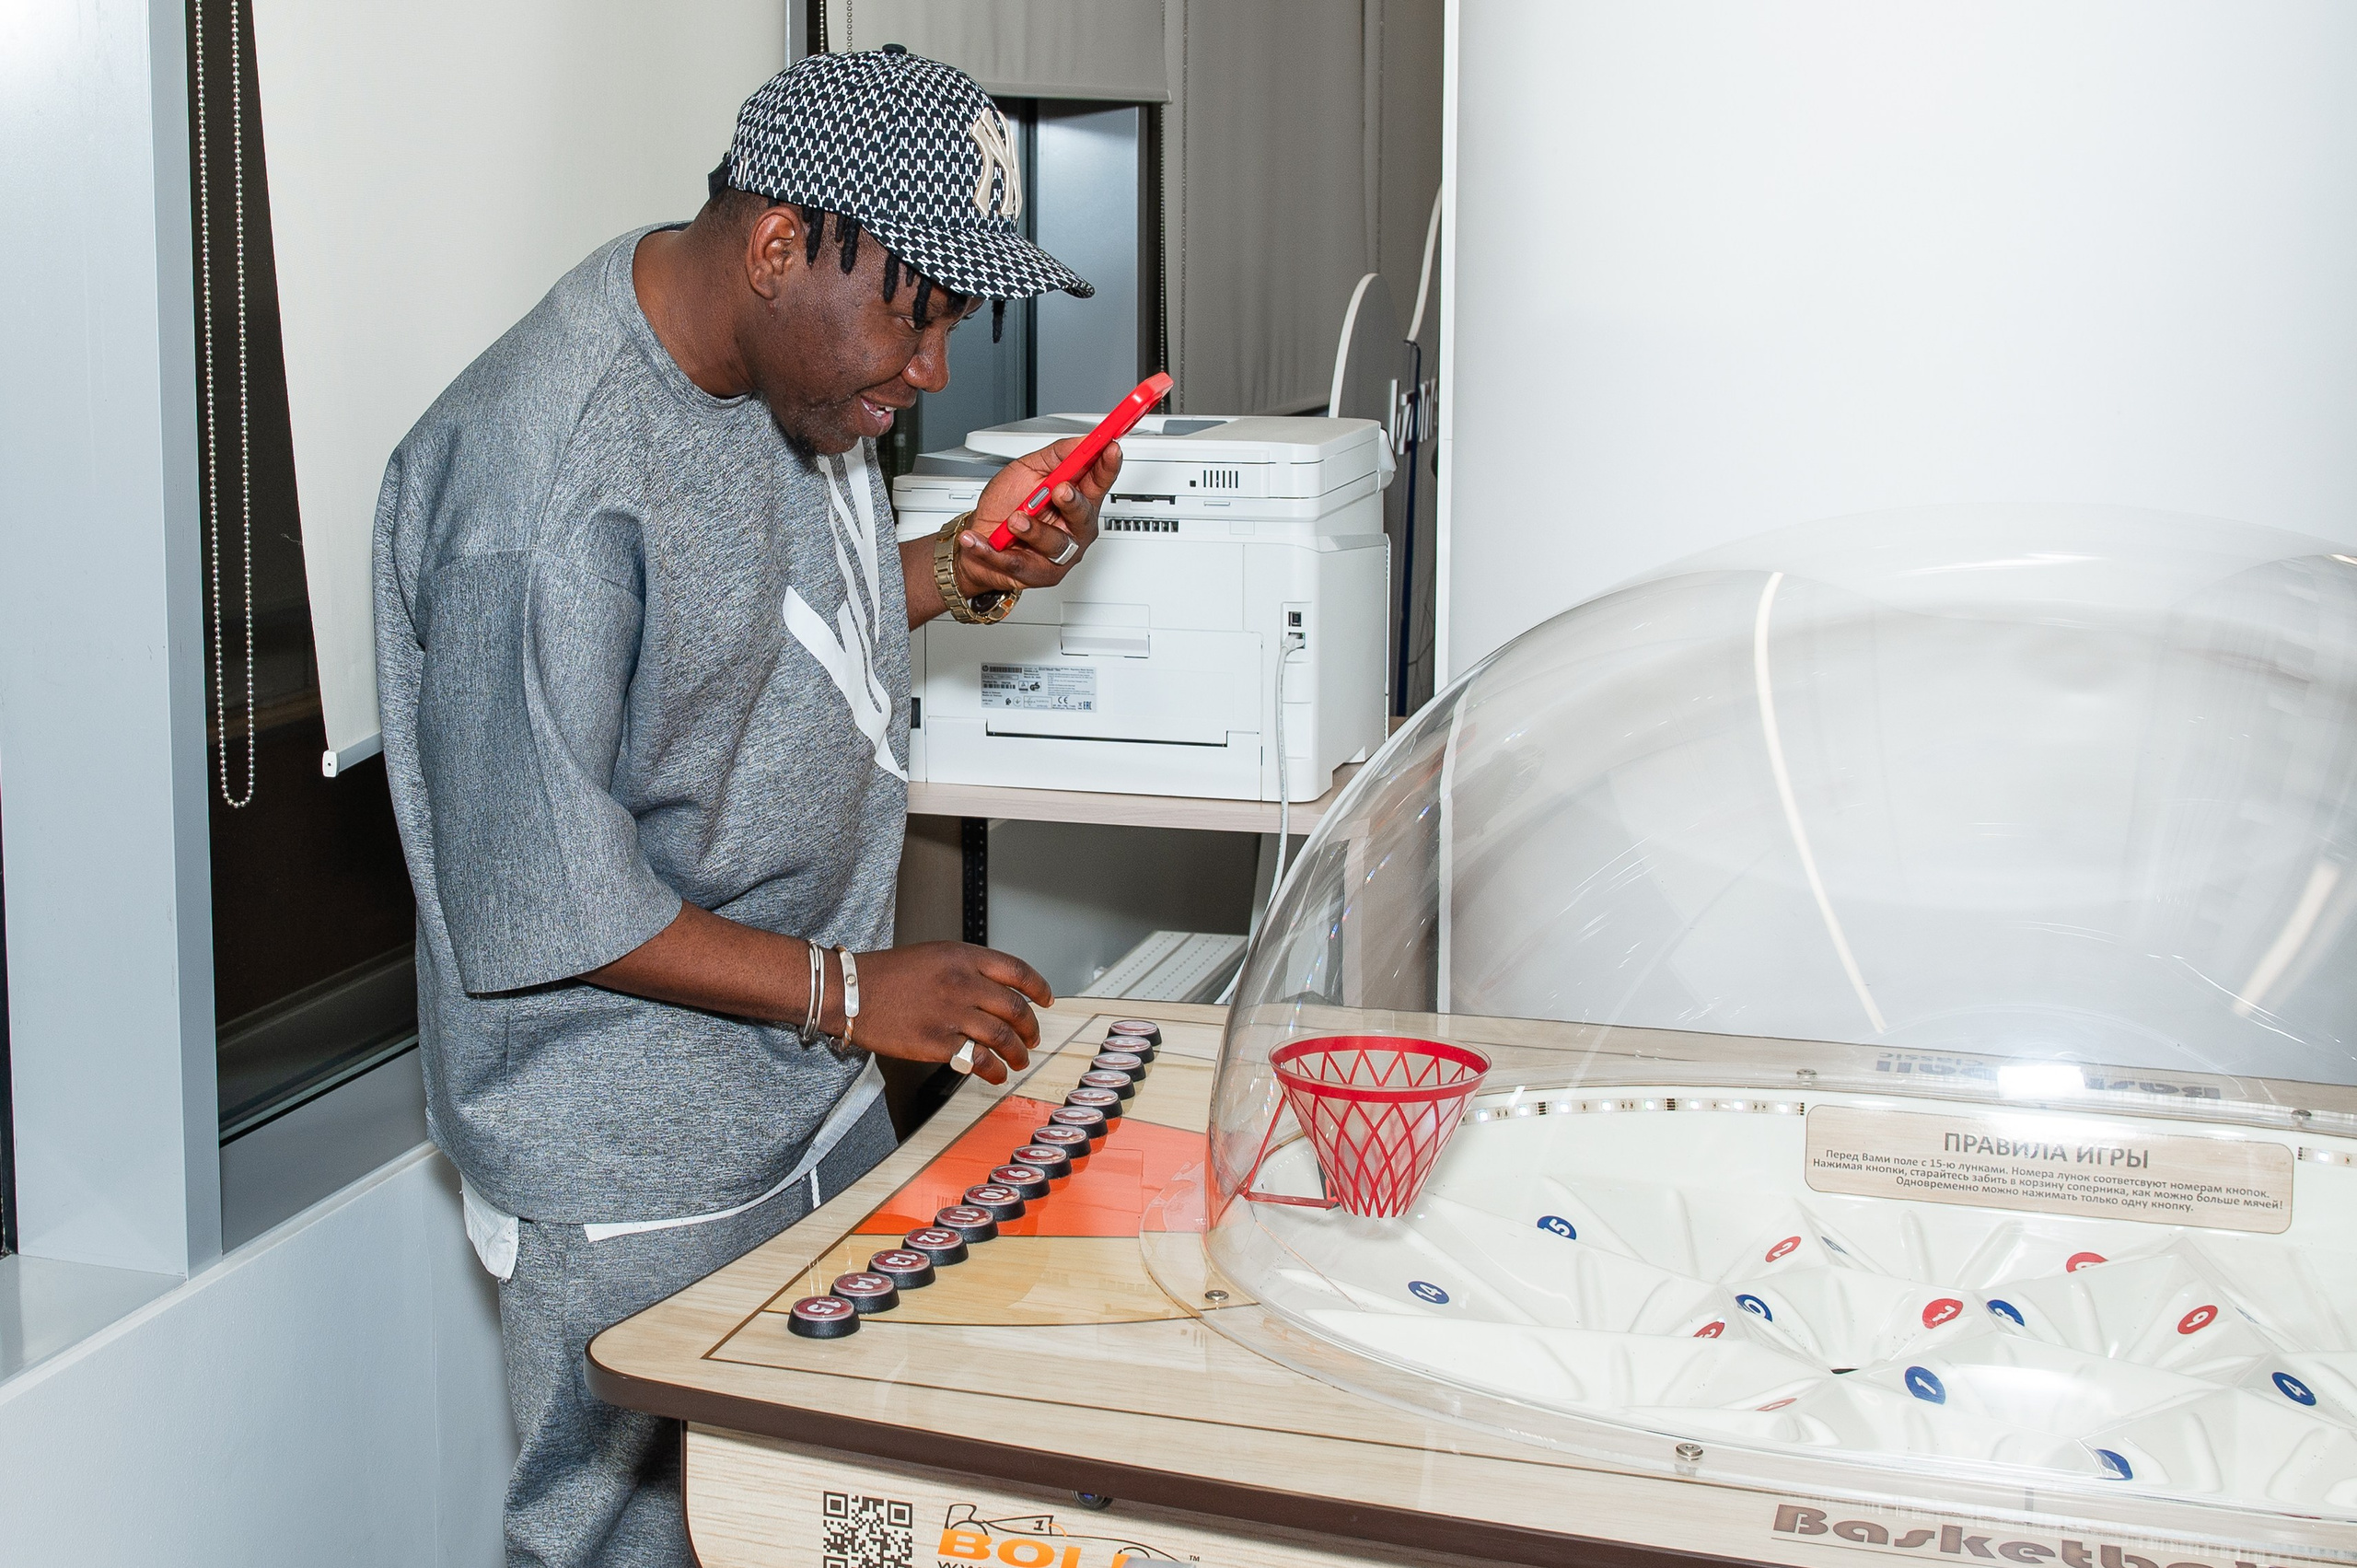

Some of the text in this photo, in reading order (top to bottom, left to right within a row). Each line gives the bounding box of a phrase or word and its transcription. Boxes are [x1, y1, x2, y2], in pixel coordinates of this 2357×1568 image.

[1944, 1132, 2148, 1168] ПРАВИЛА ИГРЫ
[1826, 1149, 1859, 1162] Перед
[1862, 1153, 1890, 1164] Вами
[1894, 1157, 1919, 1167] поле
[1930, 1158, 1956, 1169] 15-ю
[1957, 1163, 2009, 1175] лунками.
[2012, 1167, 2054, 1179] Номера
[2057, 1172, 2090, 1182] лунок
[2093, 1175, 2167, 1189] соответсвуют
[2170, 1181, 2223, 1195] номерам
[2225, 1187, 2270, 1199] кнопок.
[1813, 1158, 1863, 1170] Нажимая
[1865, 1164, 1908, 1177] кнопки,
[1910, 1168, 1969, 1181] старайтесь
[1972, 1174, 2007, 1185] забить
[2019, 1179, 2064, 1191] корзину
[2067, 1183, 2129, 1197] соперника,
[2132, 1190, 2151, 1198] как
[2154, 1191, 2193, 1202] можно
[2197, 1192, 2240, 1205] больше
[2243, 1199, 2283, 1210] мячей!
[978, 1188, 1008, 1200] 10
[1897, 1176, 2193, 1213] Одновременно можно нажимать только одну кнопку.
[949, 1210, 980, 1222] 11
[917, 1230, 949, 1244] 12
[885, 1252, 918, 1266] 13
[847, 1276, 882, 1290] 14
[1418, 1283, 1444, 1303] 14
[807, 1299, 842, 1316] 15
[1033, 1519, 1045, 1531] 1
